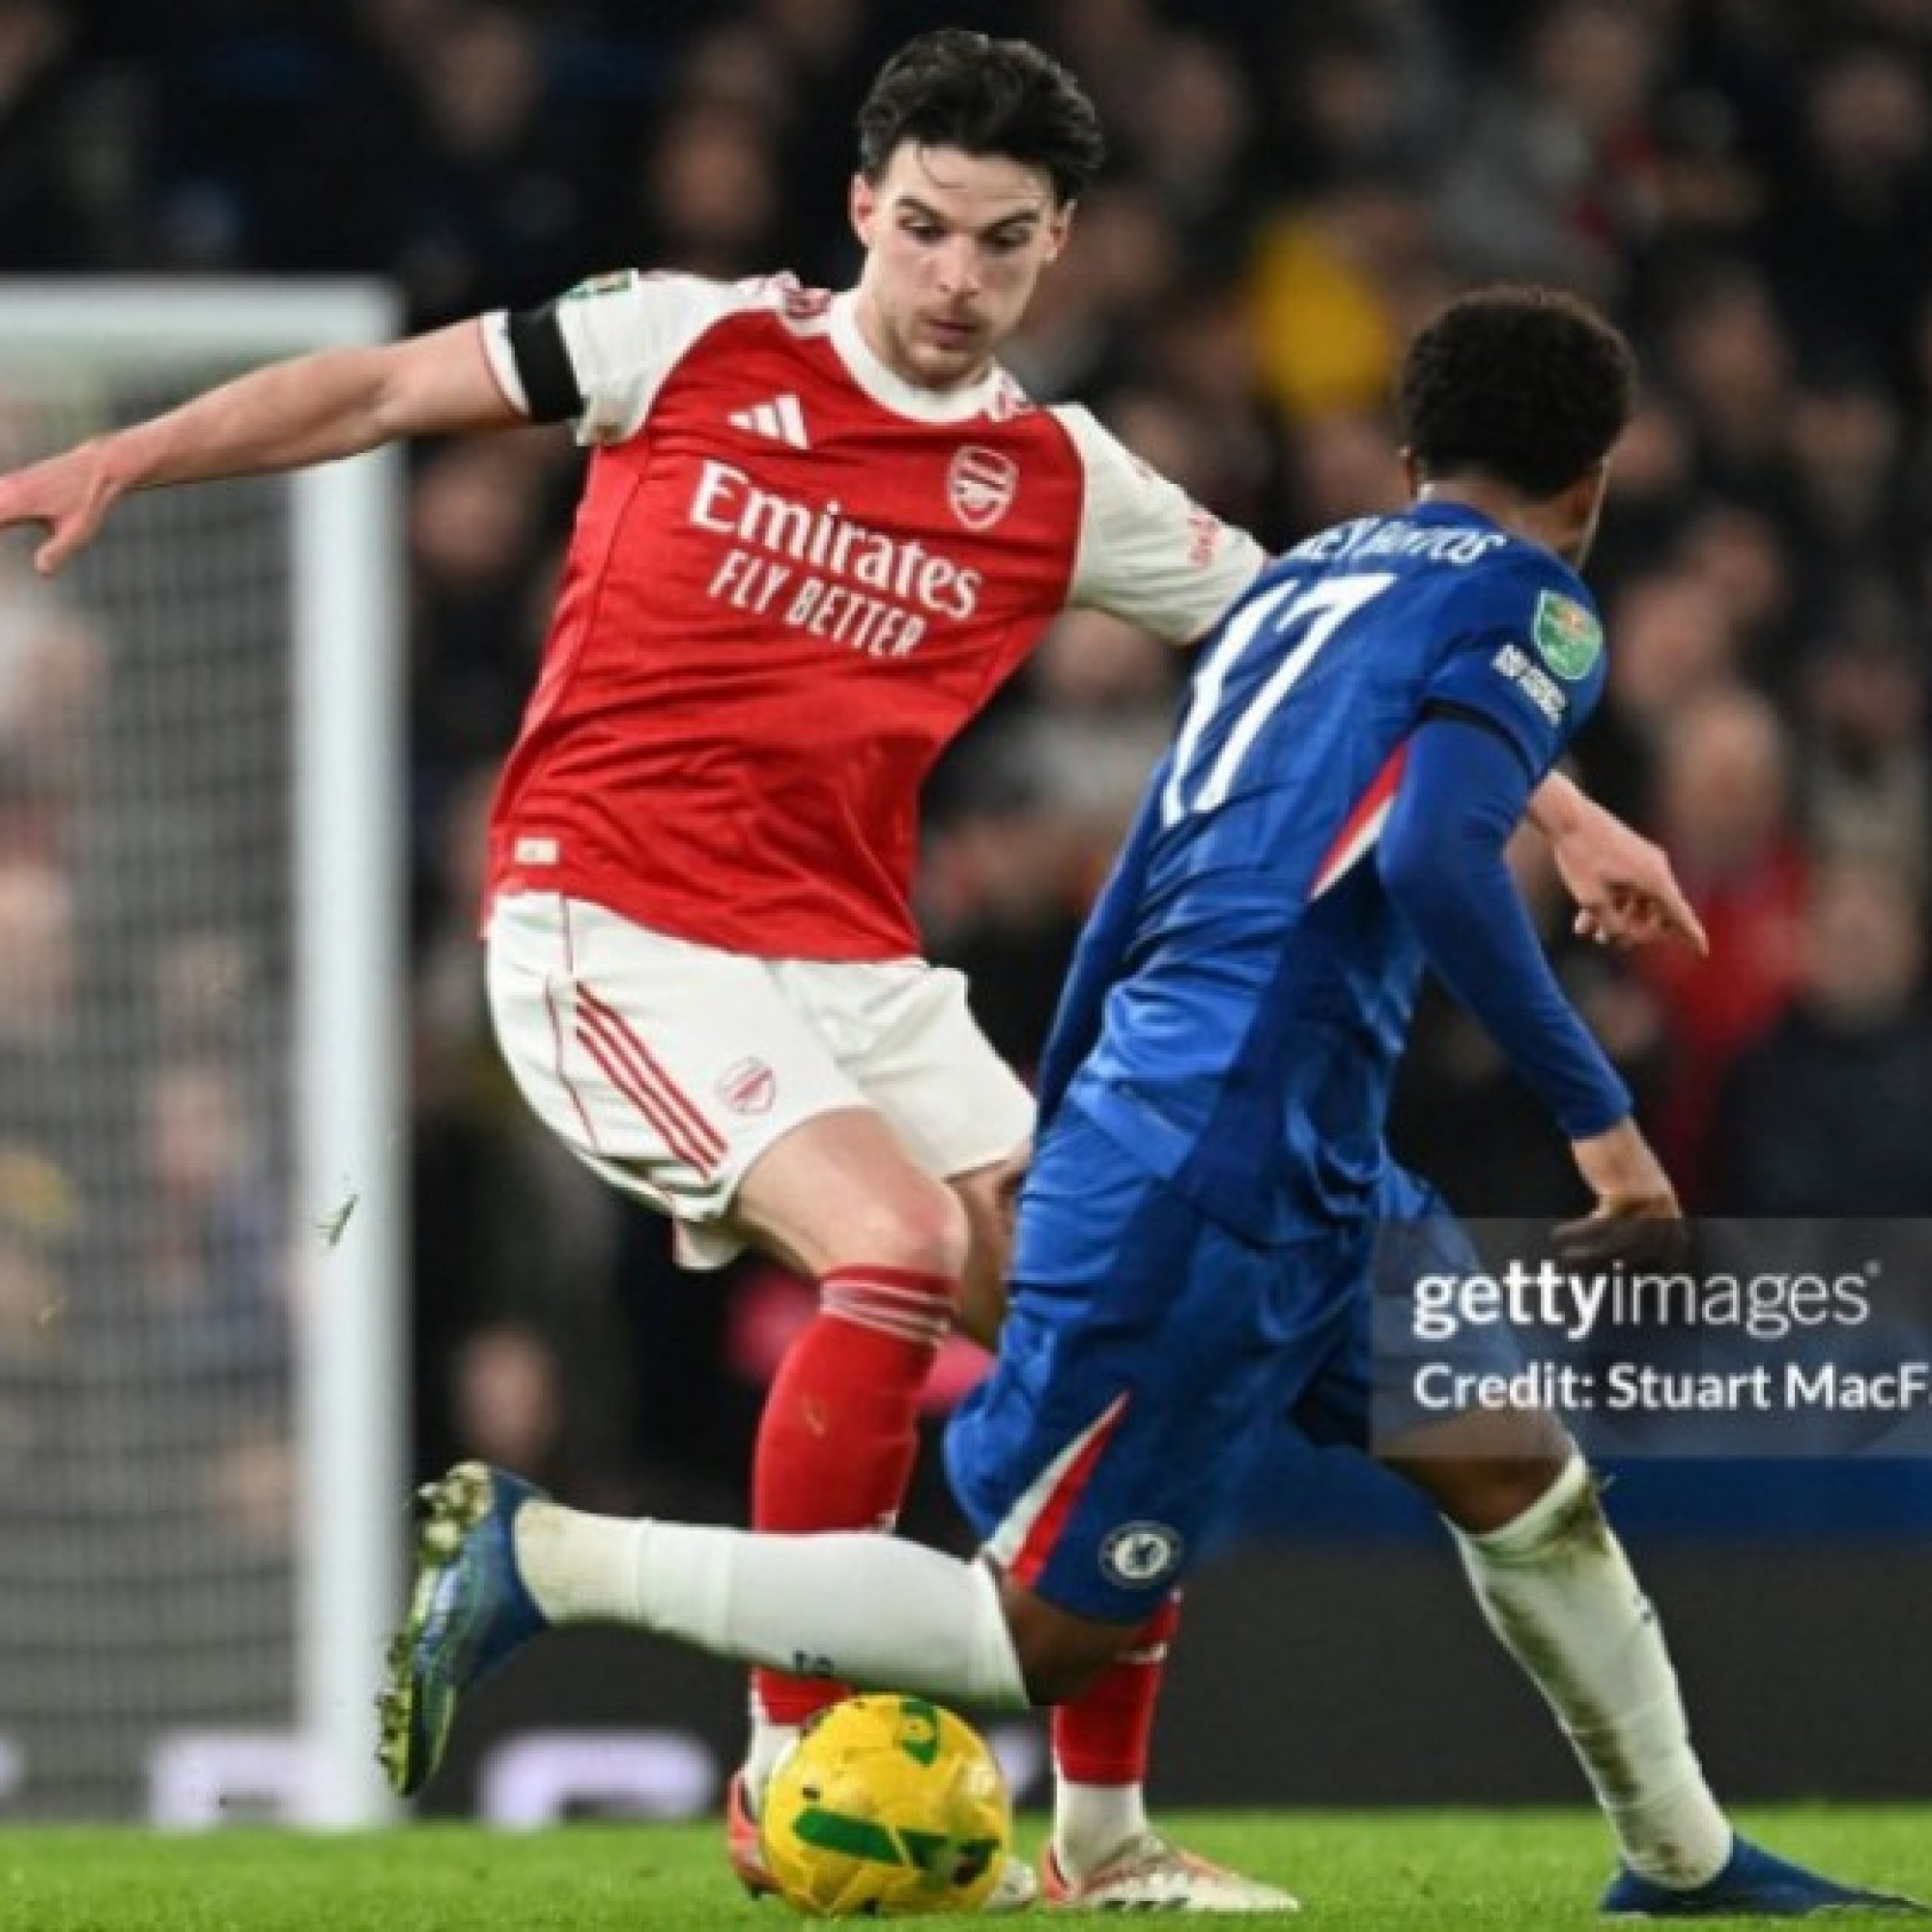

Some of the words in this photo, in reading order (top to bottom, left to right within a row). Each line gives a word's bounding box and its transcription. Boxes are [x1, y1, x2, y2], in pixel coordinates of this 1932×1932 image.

[690, 458, 982, 621] Emirates
[707, 549, 790, 614] FLY
[783, 577, 926, 658] BETTER
[1162, 572, 1398, 829] 17
